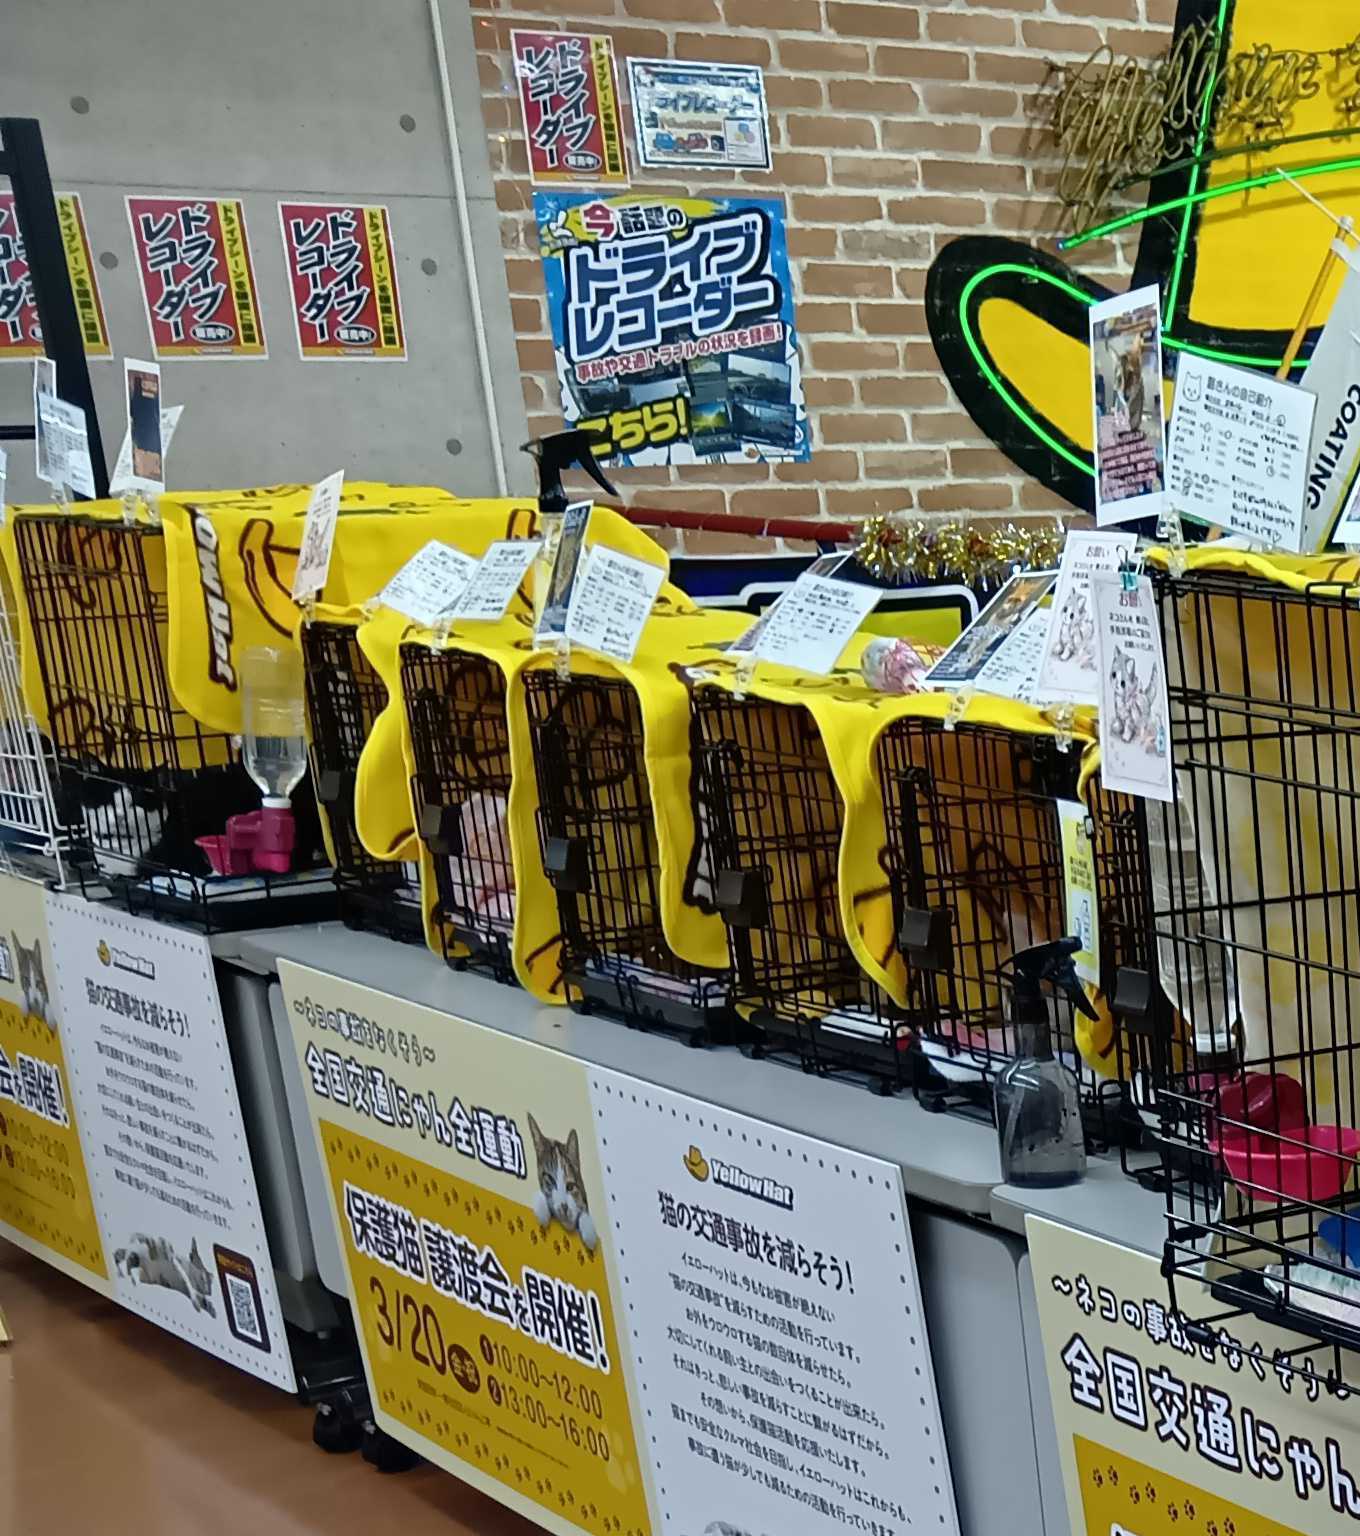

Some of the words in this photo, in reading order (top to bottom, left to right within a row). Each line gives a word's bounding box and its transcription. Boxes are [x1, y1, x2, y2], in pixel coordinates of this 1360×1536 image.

[523, 47, 563, 168] レコーダー
[572, 216, 763, 305] ドライブ
[583, 202, 686, 240] 今話題の
[140, 212, 190, 342] レコーダー
[291, 218, 335, 344] レコーダー
[572, 275, 772, 359] レコーダー
[305, 1041, 528, 1180] 全国交通にゃん全運動
[711, 1158, 794, 1211] YellowHat
[345, 1183, 427, 1284] 保護猫
[421, 1217, 611, 1375] 譲渡会を開催！
[657, 1190, 854, 1295] 猫の交通事故を減らそう！
[370, 1276, 447, 1377] 3/20
